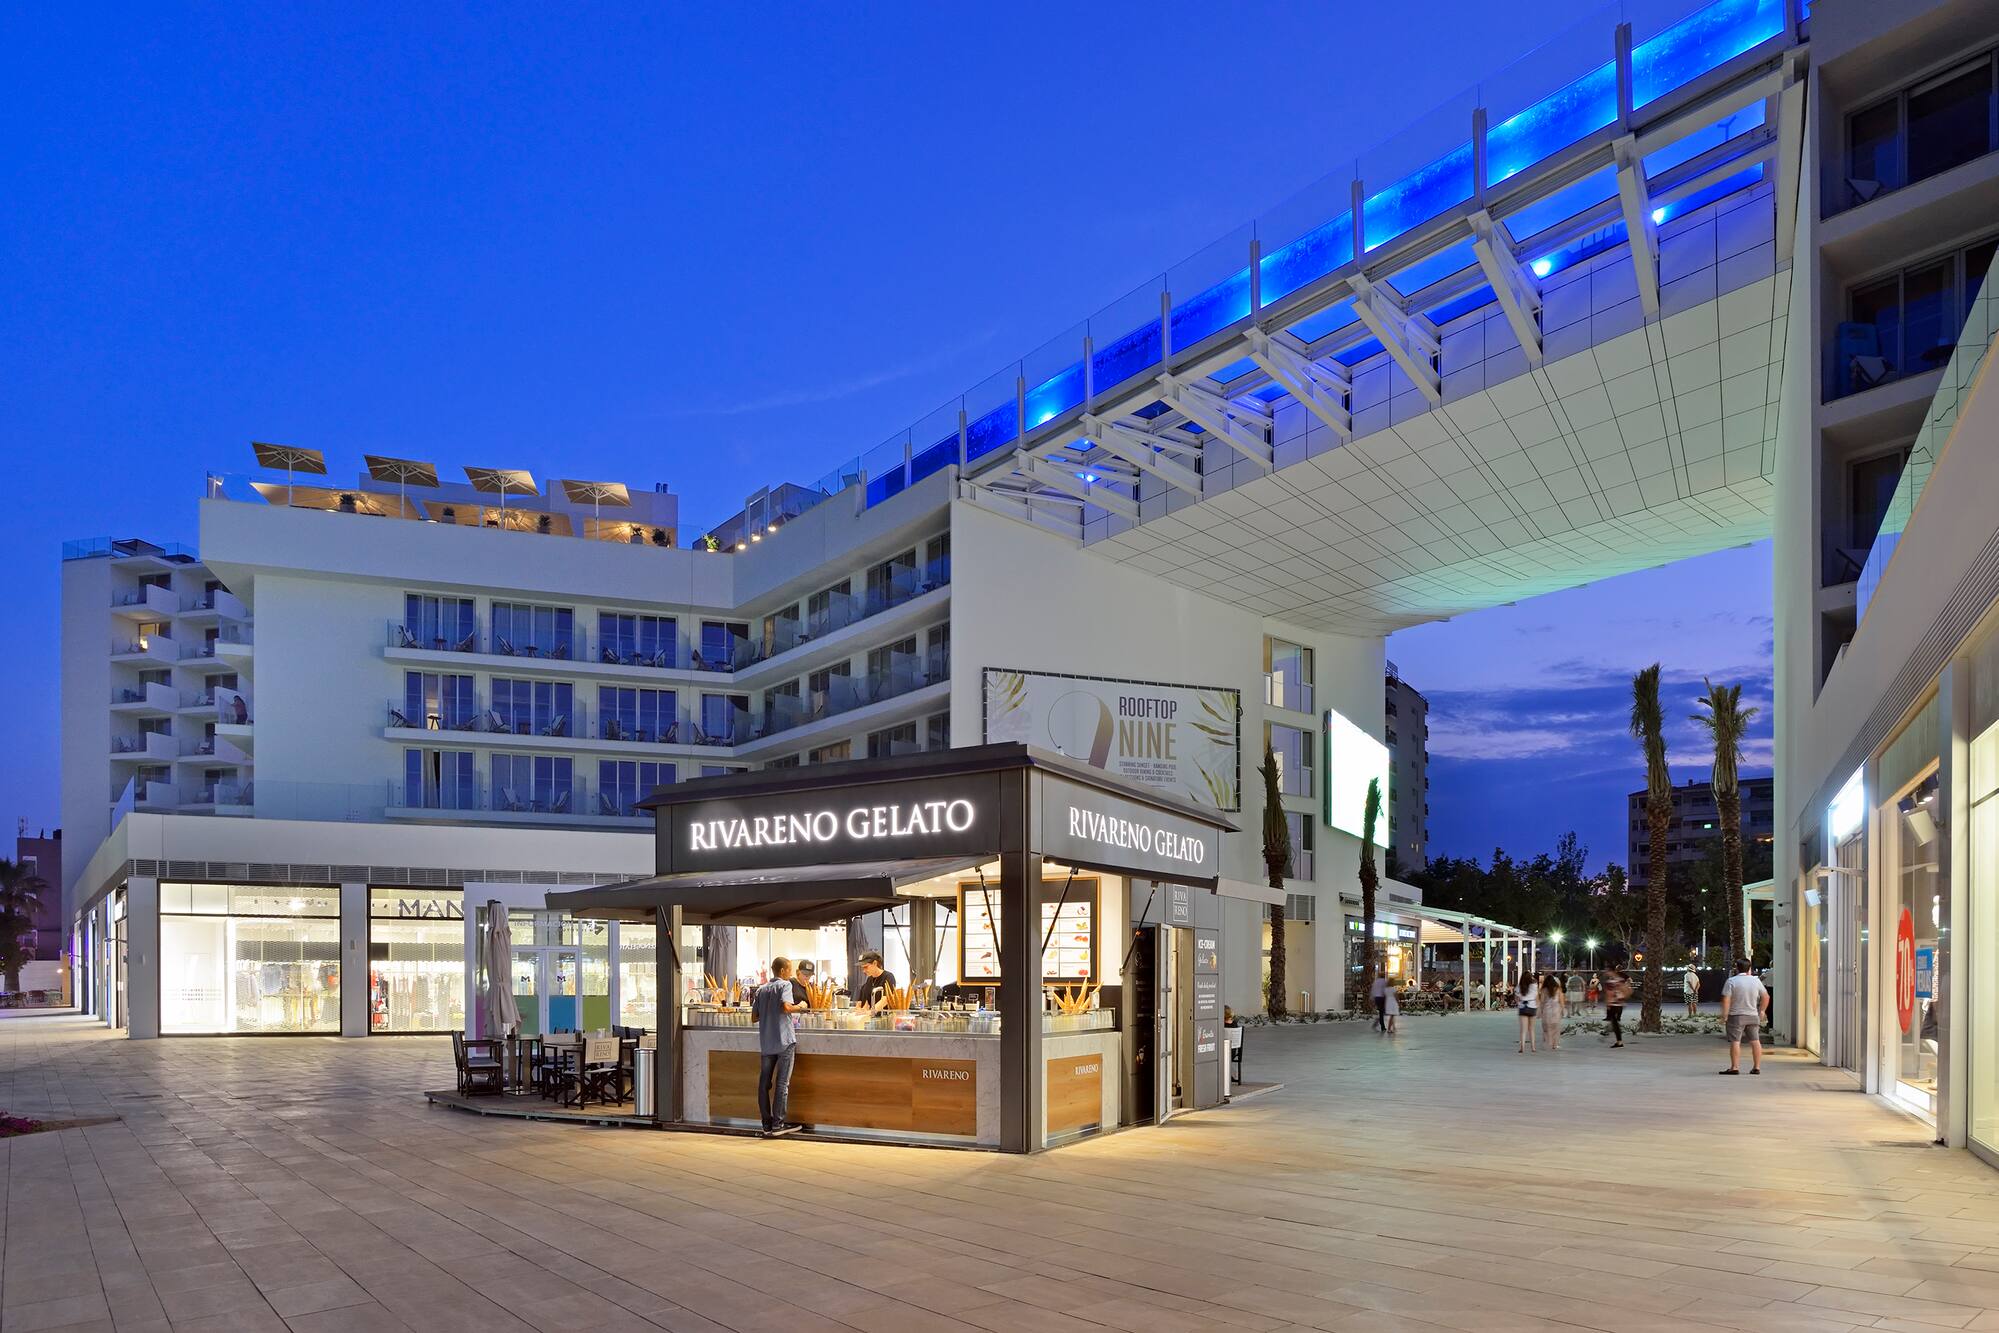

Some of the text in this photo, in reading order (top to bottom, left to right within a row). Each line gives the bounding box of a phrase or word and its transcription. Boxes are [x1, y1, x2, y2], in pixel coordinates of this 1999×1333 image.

[1119, 696, 1177, 719] ROOFTOP
[1118, 719, 1177, 760] NINE
[690, 800, 974, 850] RIVARENO GELATO
[1069, 806, 1204, 864] RIVARENO GELATO
[1174, 890, 1187, 902] RIVA
[1174, 905, 1187, 916] RENO
[922, 1069, 969, 1080] RIVARENO
[1075, 1063, 1098, 1076] RIVARENO
